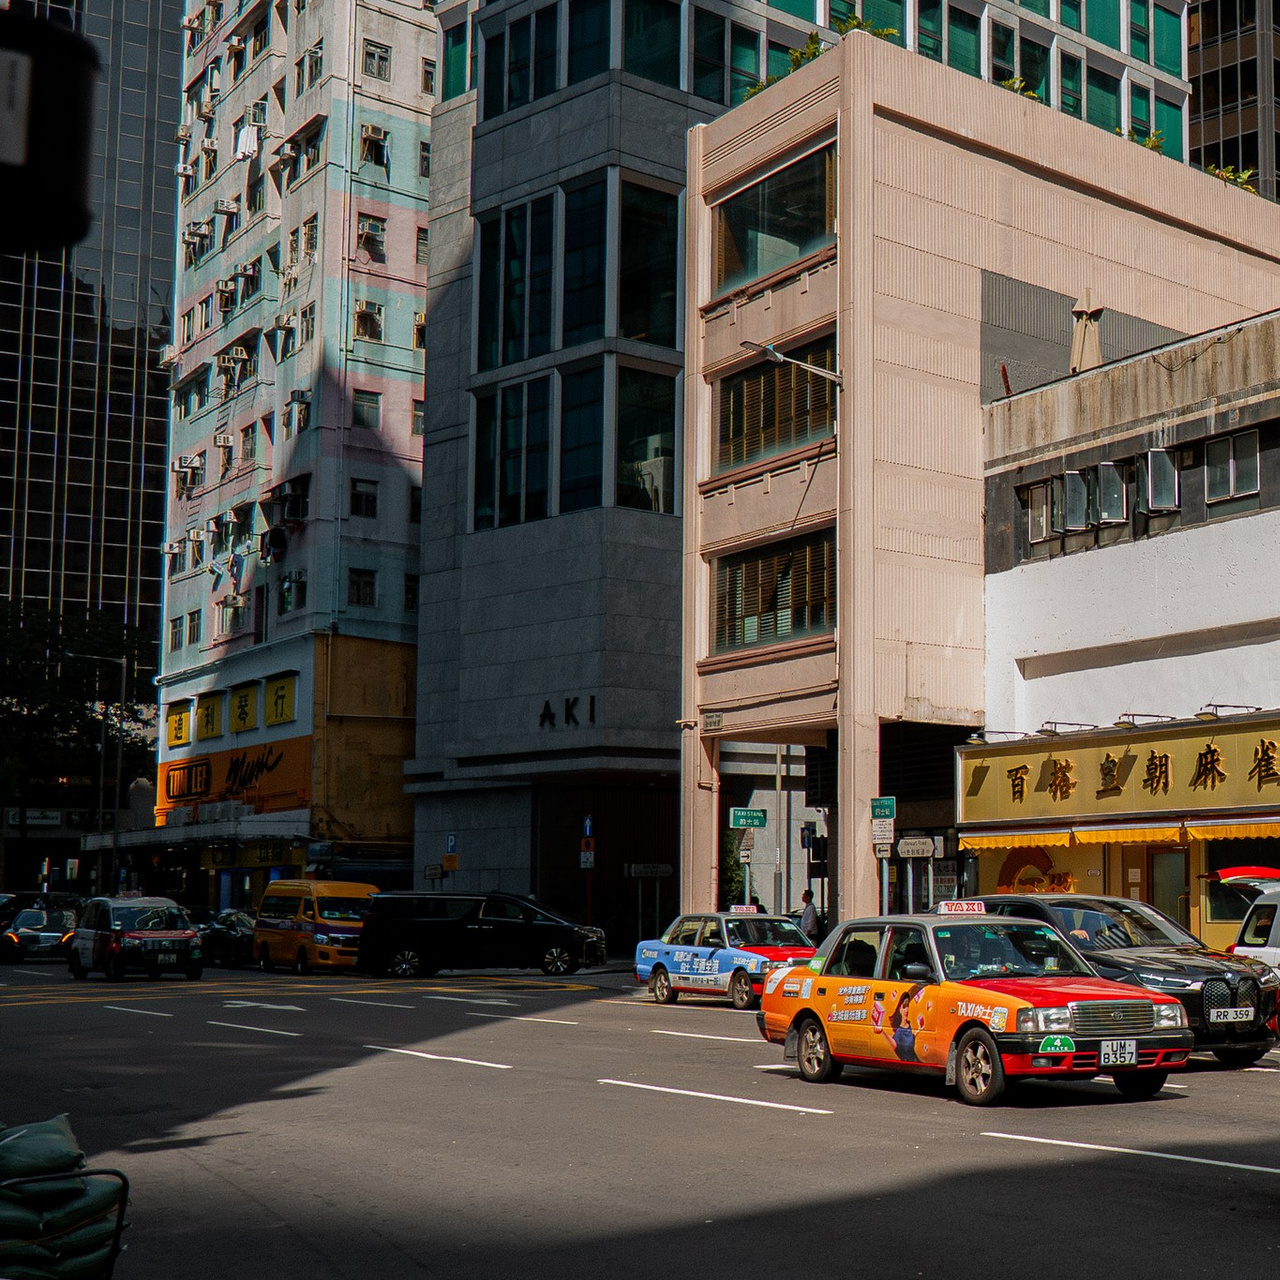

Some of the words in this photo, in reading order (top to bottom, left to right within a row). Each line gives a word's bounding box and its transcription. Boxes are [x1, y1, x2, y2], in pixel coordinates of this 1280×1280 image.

[539, 695, 596, 728] AKI
[945, 902, 982, 912] TAXI
[1216, 1011, 1229, 1020] RR
[1232, 1009, 1250, 1019] 359
[1111, 1042, 1127, 1052] UM
[1103, 1052, 1134, 1064] 8357
